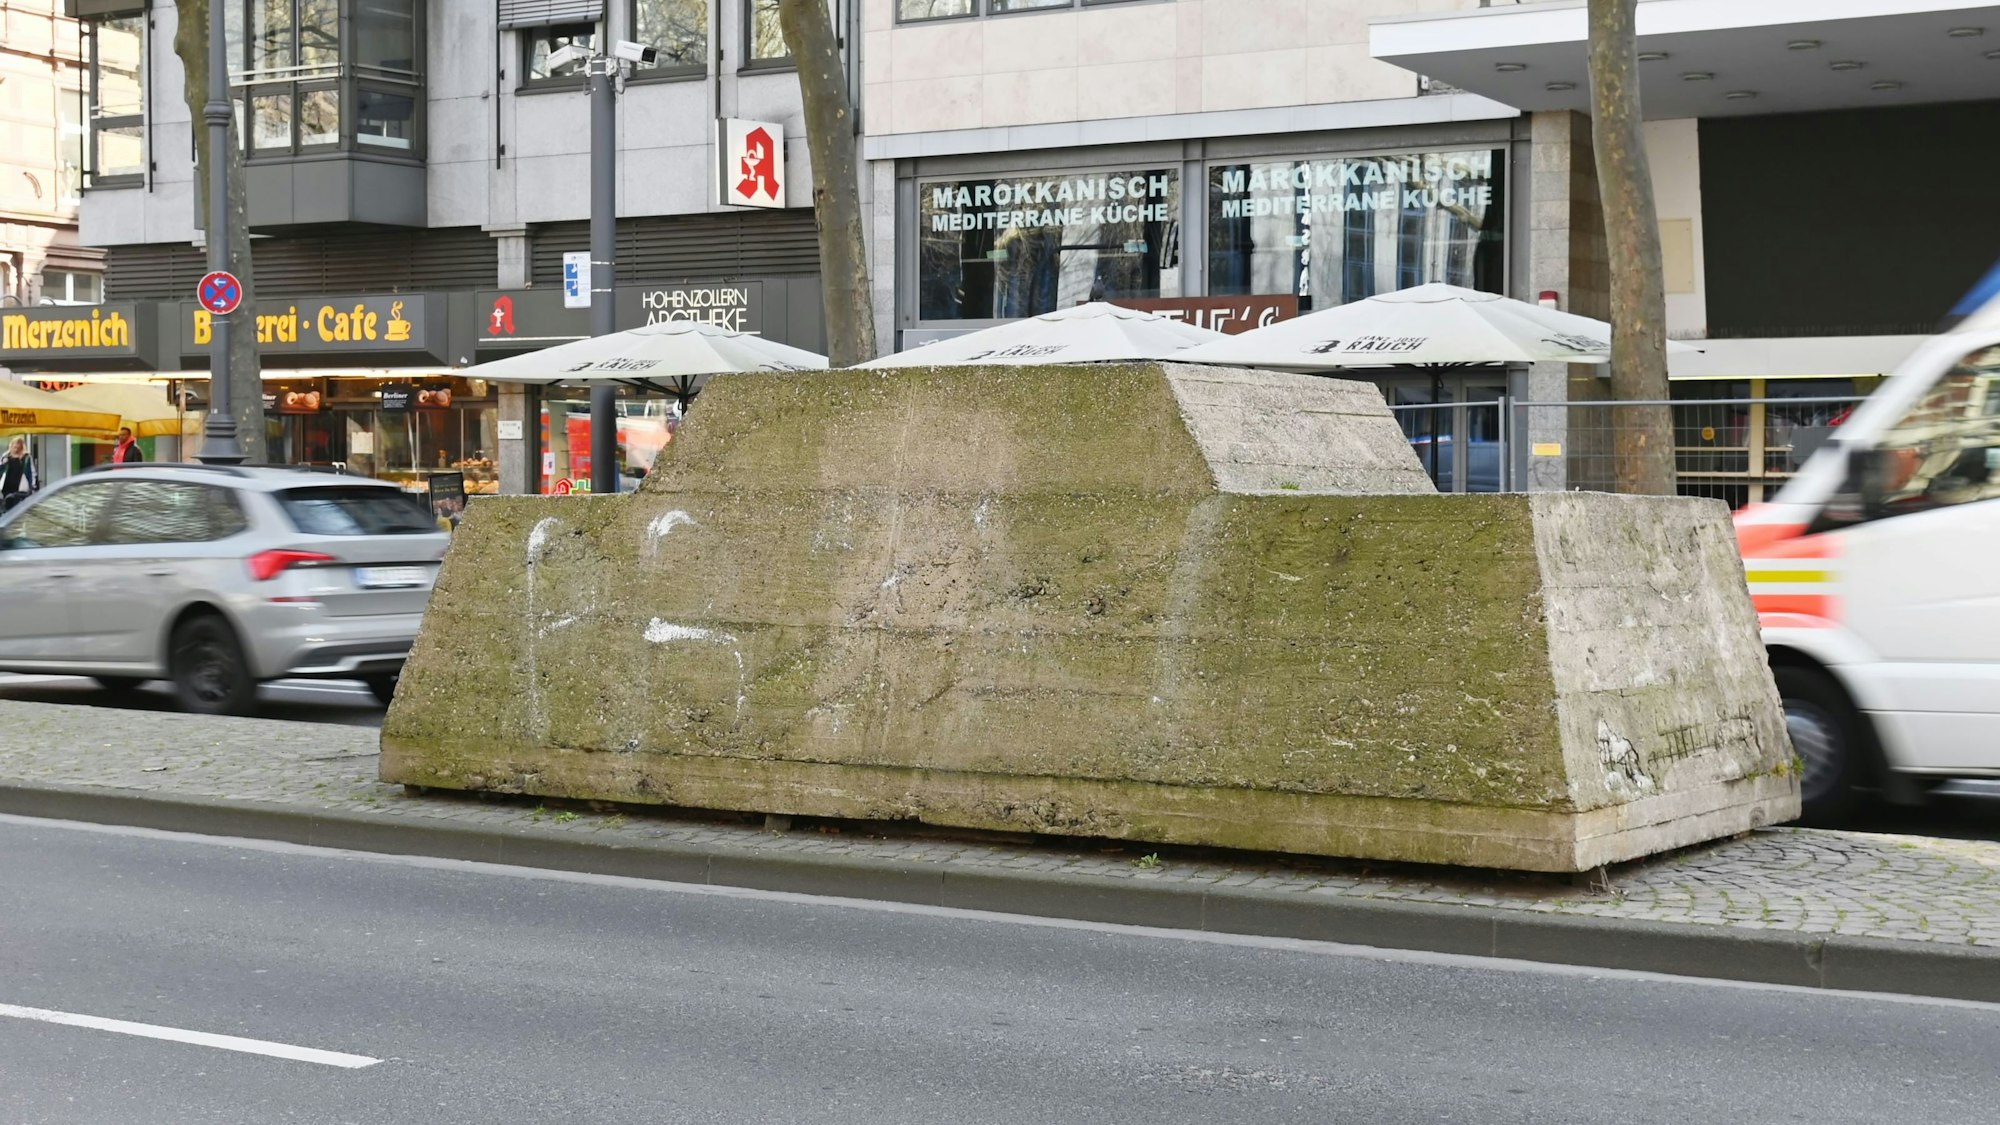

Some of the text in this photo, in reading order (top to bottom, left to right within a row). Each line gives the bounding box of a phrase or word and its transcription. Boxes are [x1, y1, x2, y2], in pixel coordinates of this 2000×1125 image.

[1222, 156, 1492, 193] MAROKKANISCH
[932, 175, 1169, 209] MAROKKANISCH
[1222, 191, 1396, 219] MEDITERRANE
[931, 203, 1169, 232] MEDITERRANE KÜCHE
[642, 287, 748, 309] HOHENZOLLERN
[2, 308, 128, 349] Merzenich
[193, 304, 378, 345] Berei Cafe
[1345, 340, 1424, 351] RAUCH
